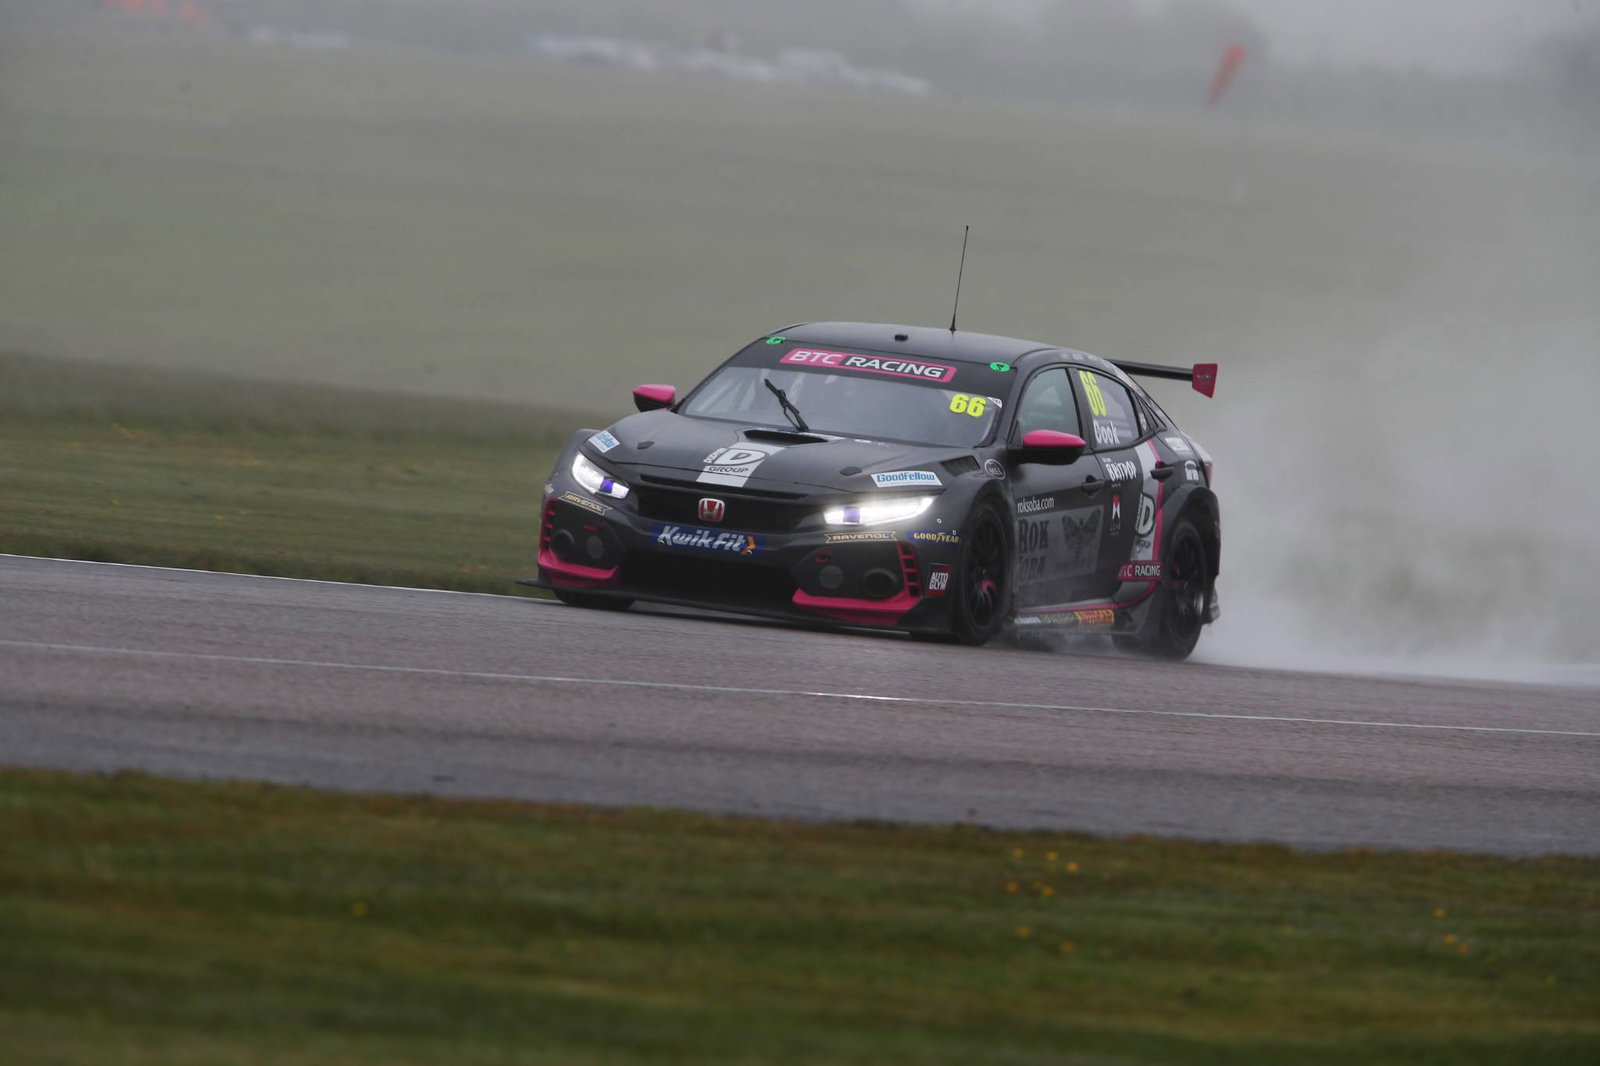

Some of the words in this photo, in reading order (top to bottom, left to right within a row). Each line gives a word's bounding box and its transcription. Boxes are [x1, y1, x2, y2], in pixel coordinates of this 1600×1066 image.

[789, 351, 842, 364] BTC
[844, 356, 944, 378] RACING
[1079, 370, 1106, 417] 66
[949, 393, 986, 417] 66
[1093, 419, 1120, 444] Cook
[565, 494, 604, 512] RAVENOL
[1017, 496, 1054, 513] roksoba.com
[832, 533, 890, 541] RAVENOL
[913, 531, 960, 543] GOODYEAR
[931, 571, 949, 581] AUTO
[1134, 565, 1161, 577] RACING
[928, 580, 947, 590] GLYM
